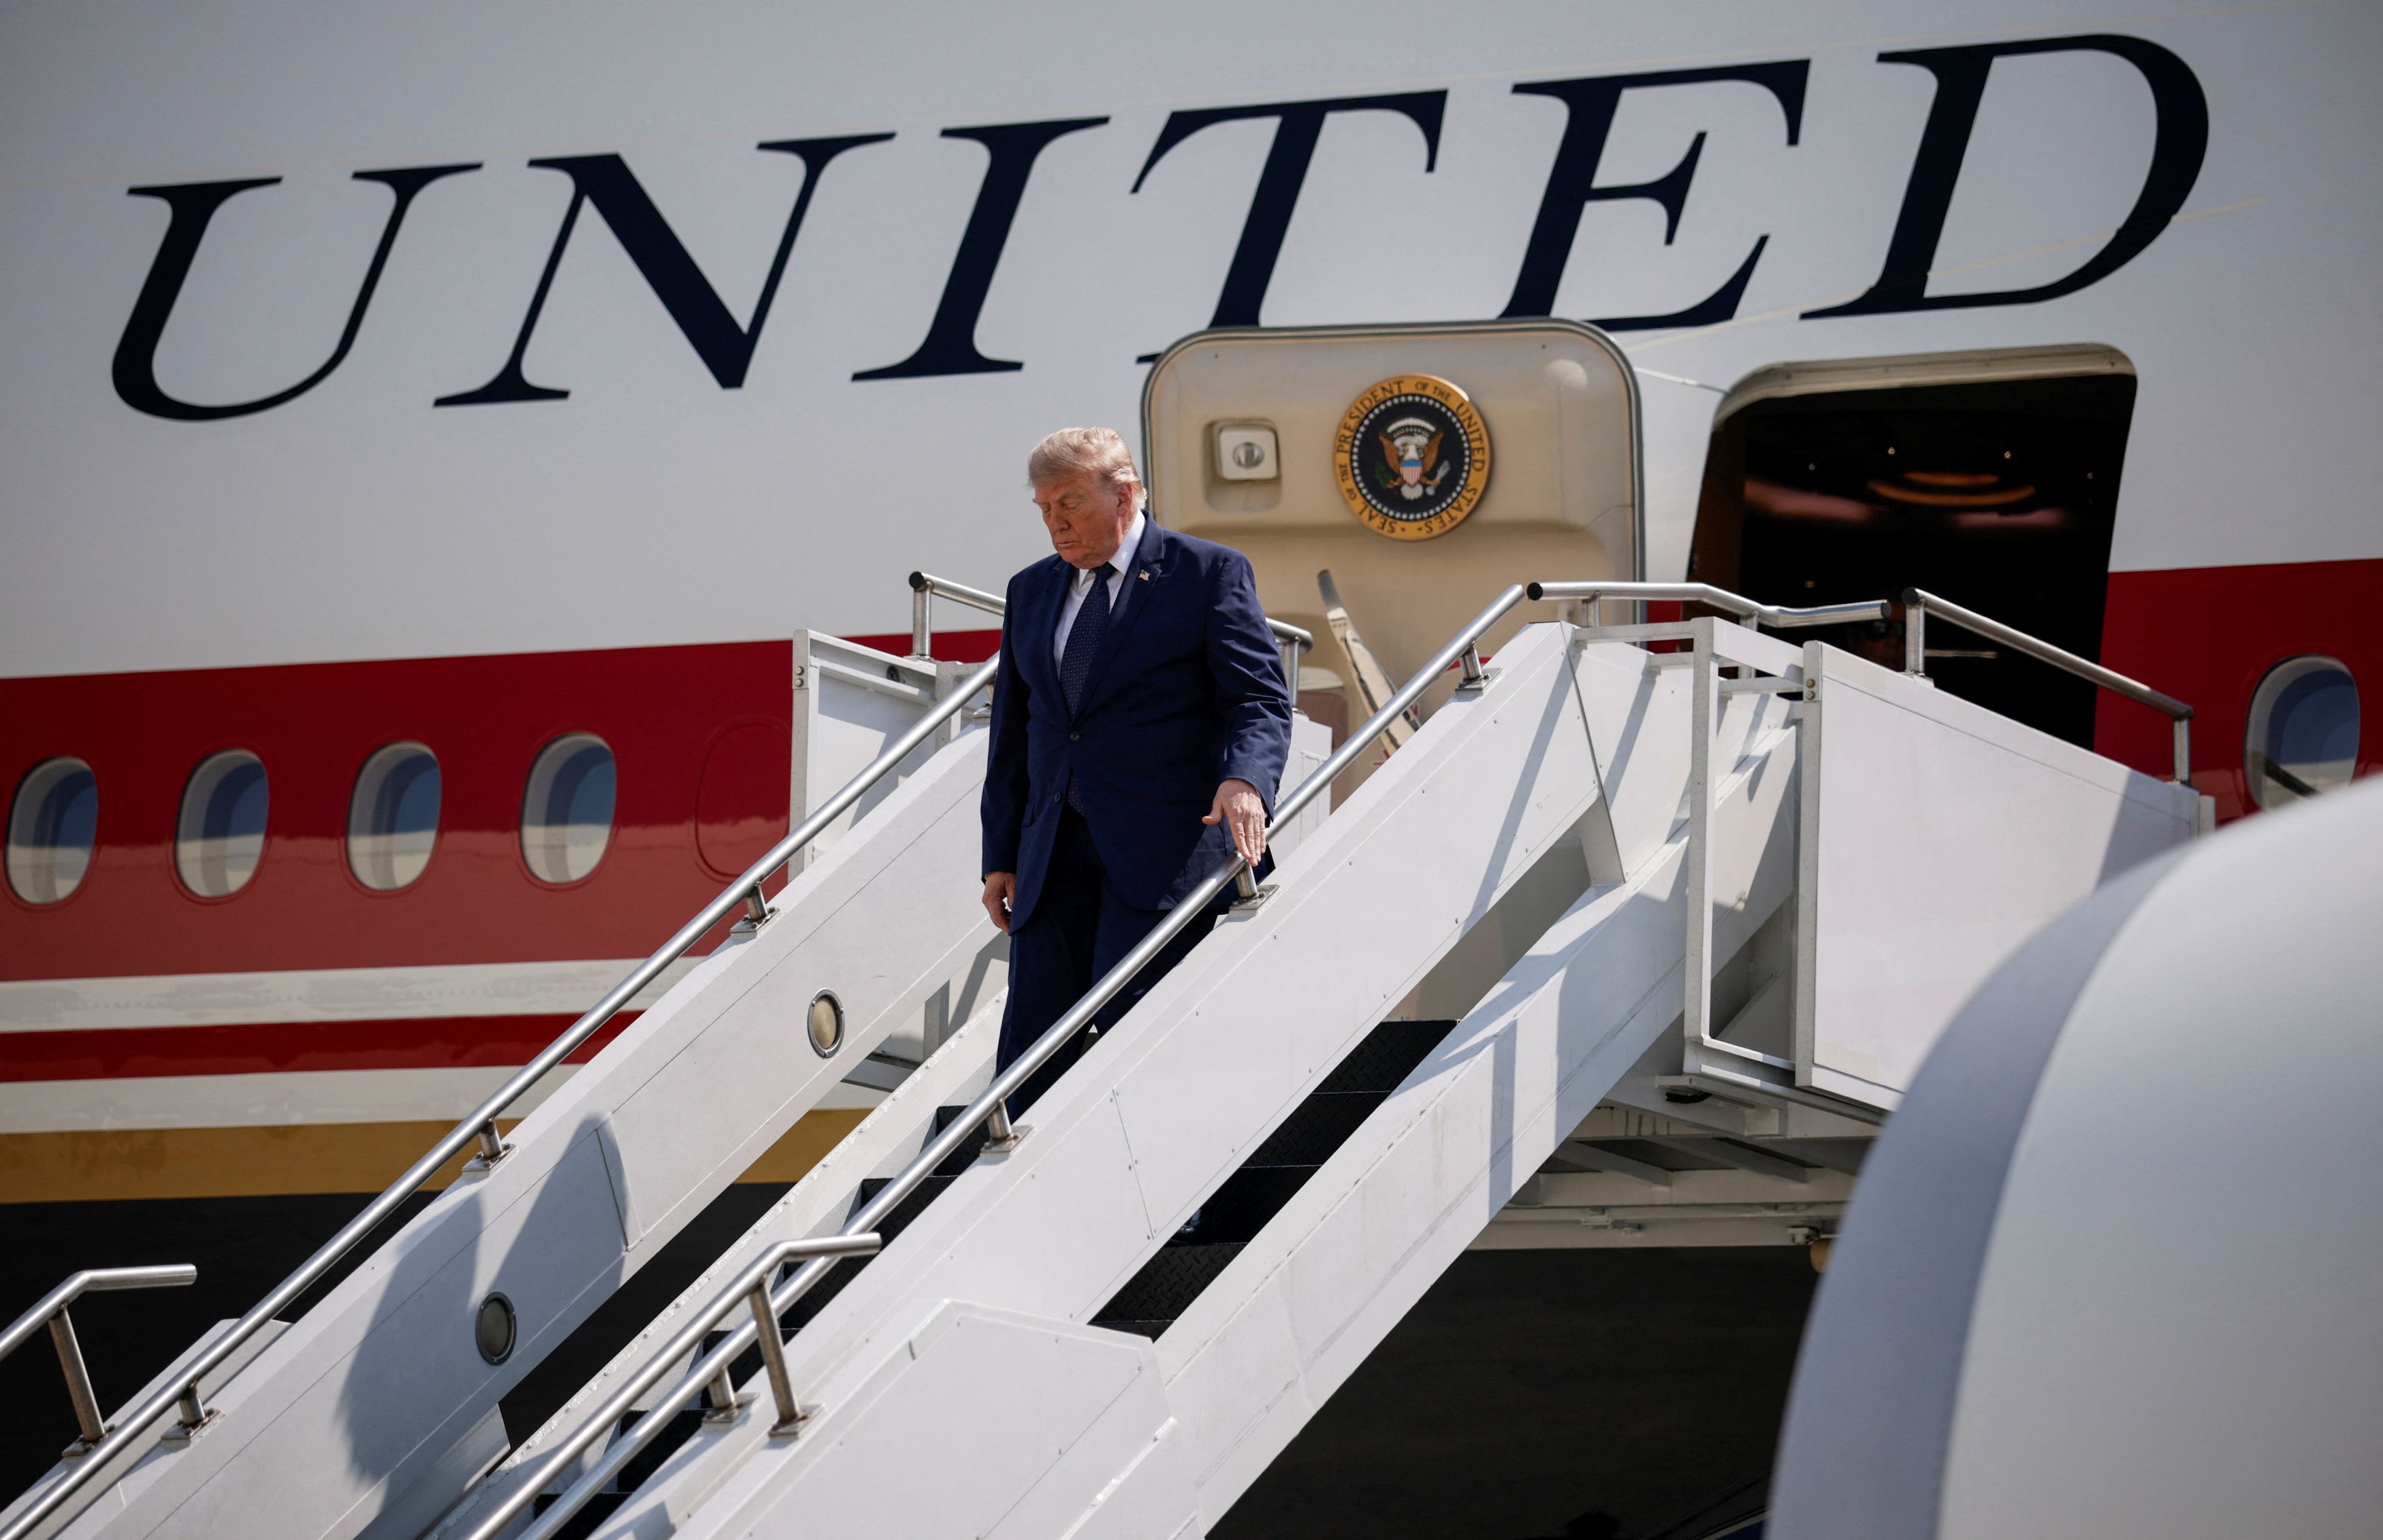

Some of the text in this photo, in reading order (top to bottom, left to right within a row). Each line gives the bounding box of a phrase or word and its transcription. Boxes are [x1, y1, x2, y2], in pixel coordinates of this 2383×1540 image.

[112, 33, 2209, 422] UNITED
[1336, 380, 1486, 534] SEAL OF THE PRESIDENT OF THE UNITED STATES
